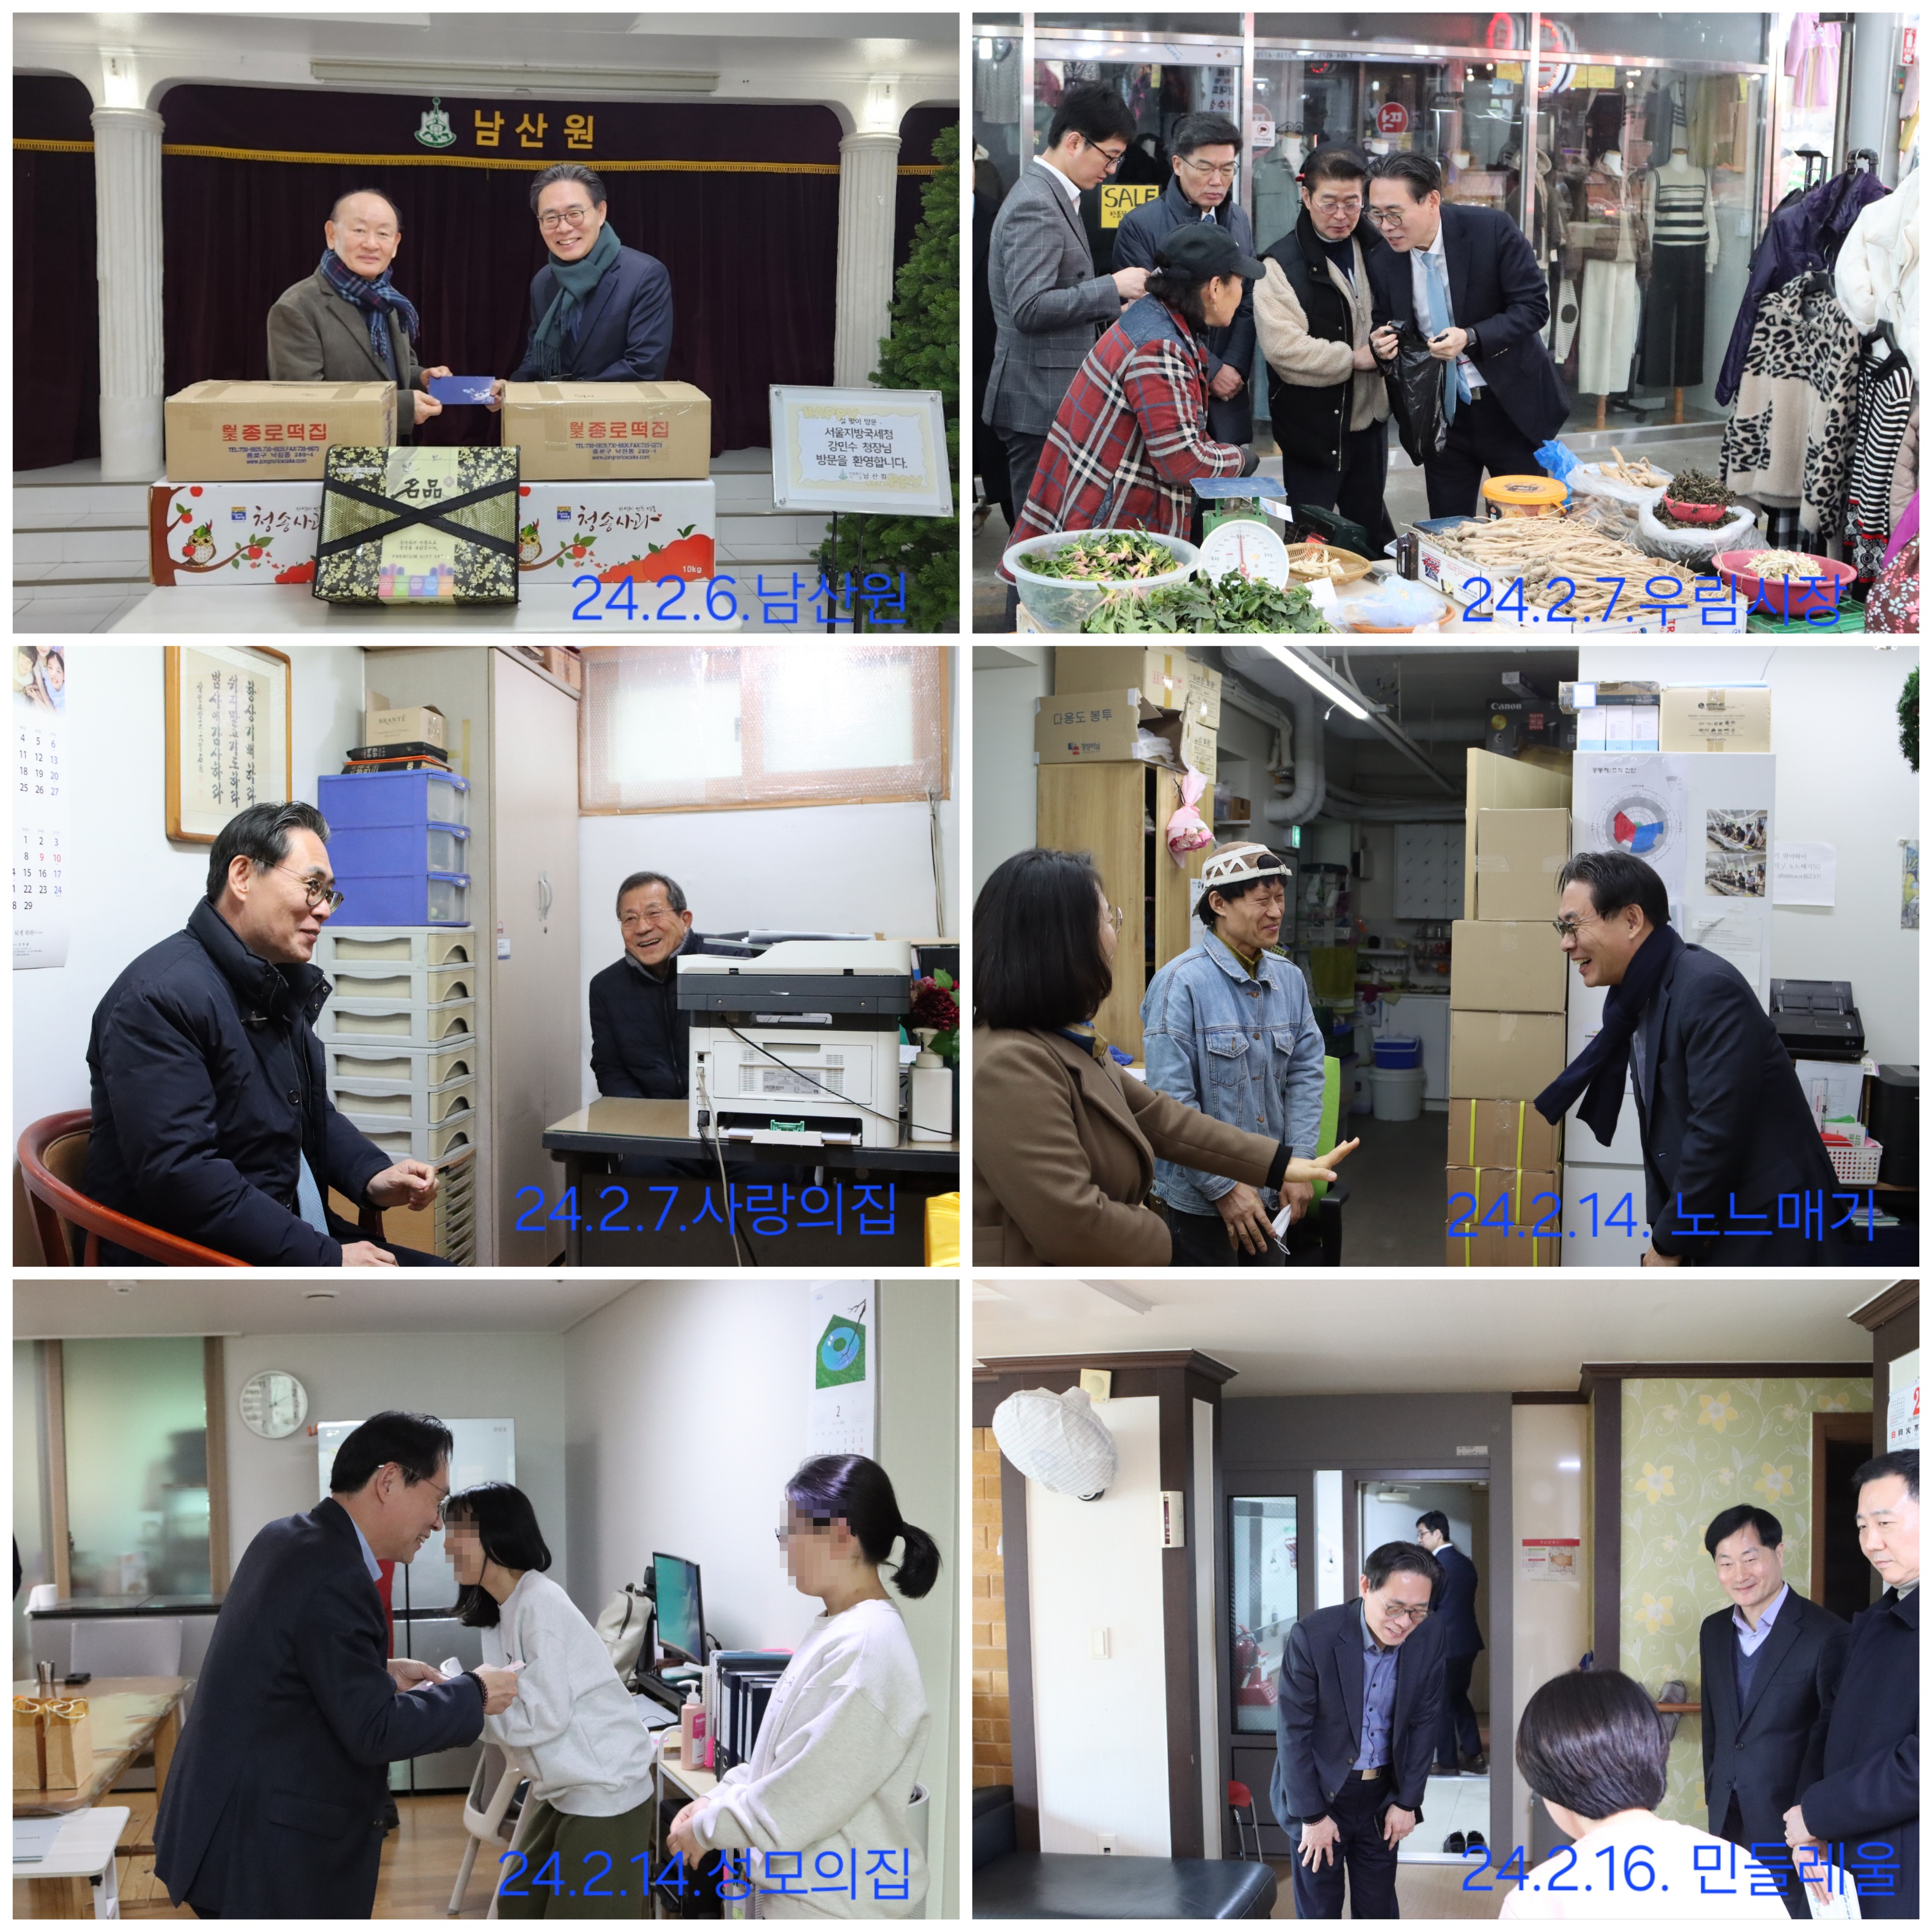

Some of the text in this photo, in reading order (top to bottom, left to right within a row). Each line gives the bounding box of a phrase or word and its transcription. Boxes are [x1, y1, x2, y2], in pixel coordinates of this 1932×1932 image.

[474, 110, 594, 149] 남산원
[1105, 188, 1156, 207] SALE
[242, 424, 327, 441] 종로떡집
[588, 421, 668, 438] 종로떡집
[825, 427, 893, 439] 서울지방국세청
[828, 441, 892, 453] 강민수 청장님
[816, 454, 907, 469] 방문을 환영합니다.
[390, 478, 442, 499] 名品
[682, 565, 702, 574] 10kg
[379, 714, 406, 724] BRANTÉ
[1054, 709, 1113, 725] 다용도 봉투
[21, 733, 25, 742] 4
[36, 737, 40, 745] 5
[19, 750, 58, 765] 11 12 13
[20, 766, 59, 780] 18 19 20
[20, 783, 59, 796] 25 26 27
[24, 835, 27, 844] 1
[39, 837, 44, 845] 2
[54, 854, 61, 862] 10
[23, 868, 31, 877] 15
[38, 869, 47, 877] 16
[54, 870, 61, 878] 17
[23, 885, 32, 893] 22
[39, 886, 47, 894] 23
[54, 886, 62, 894] 24
[24, 901, 32, 910] 29
